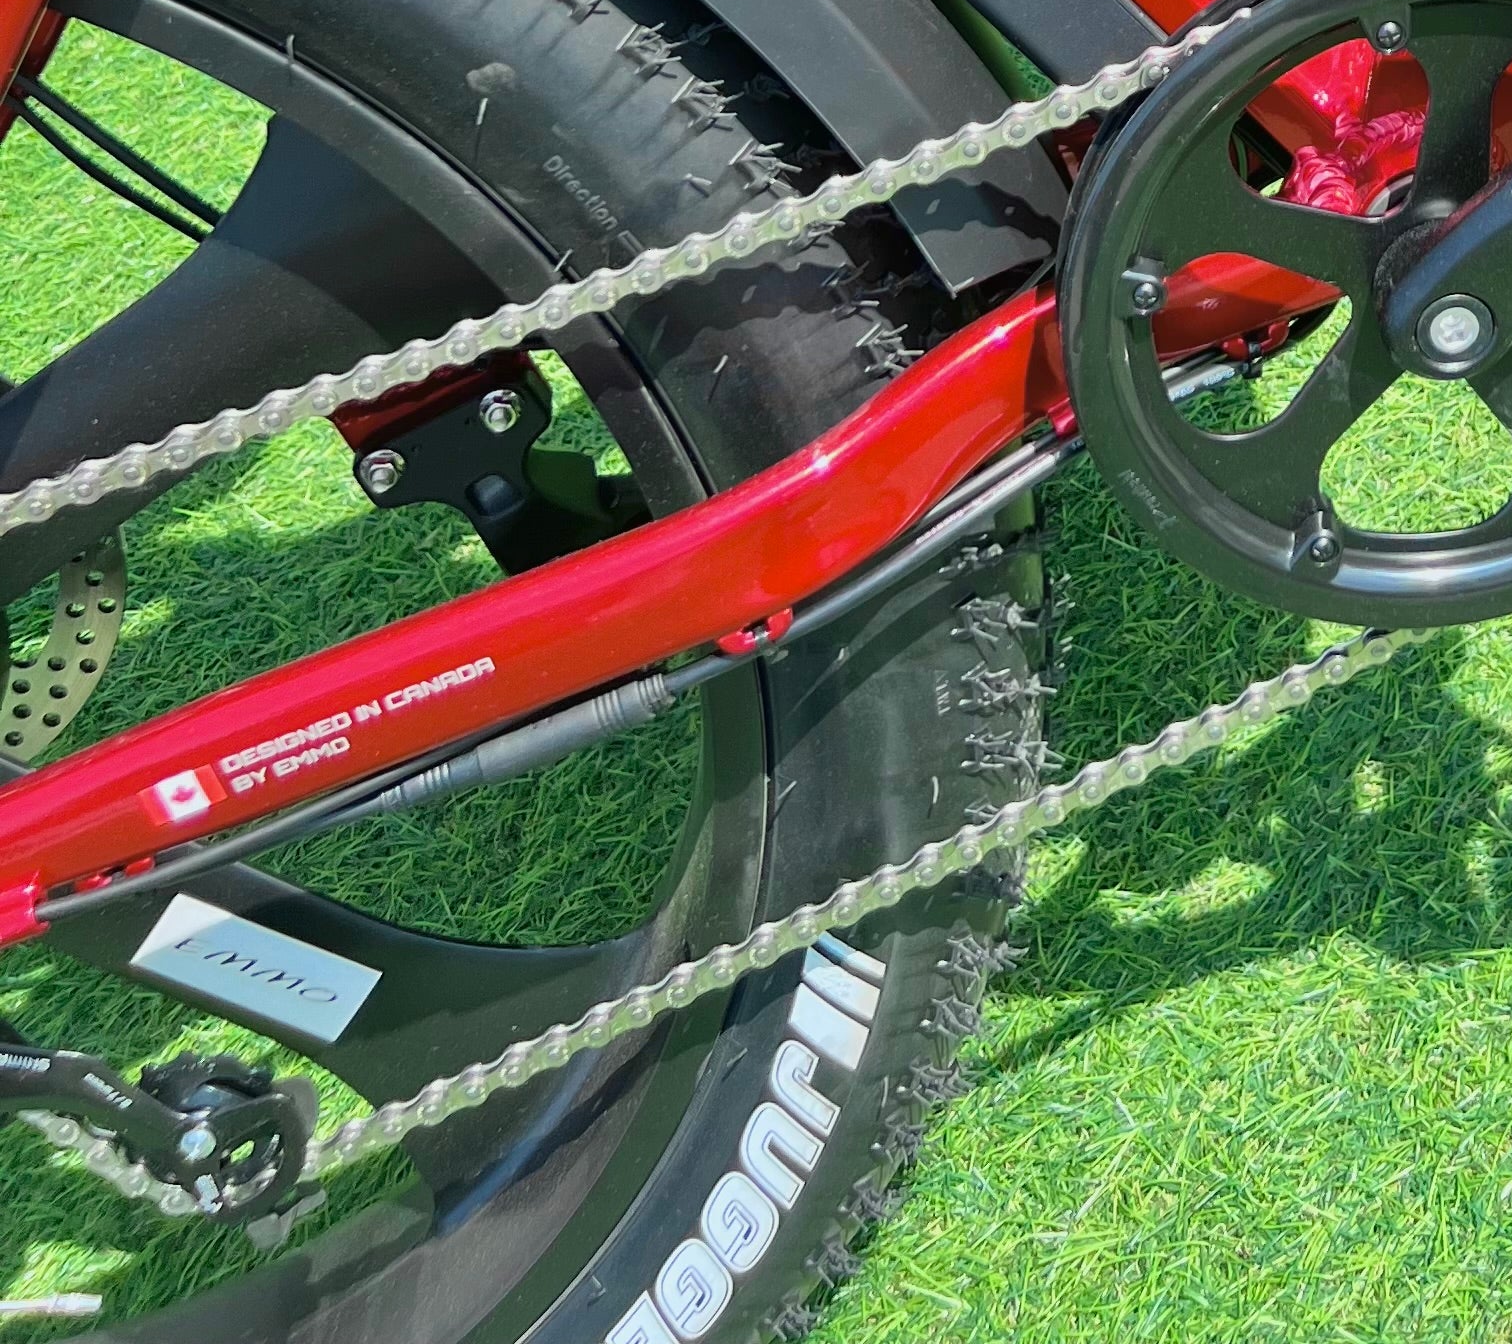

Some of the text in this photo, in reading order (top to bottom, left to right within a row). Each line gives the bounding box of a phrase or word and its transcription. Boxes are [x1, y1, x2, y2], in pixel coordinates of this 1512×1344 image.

[543, 155, 618, 230] Direction
[217, 656, 496, 774] DESIGNED IN CANADA
[231, 736, 350, 793] BY EMMO
[174, 937, 338, 1004] EMMO
